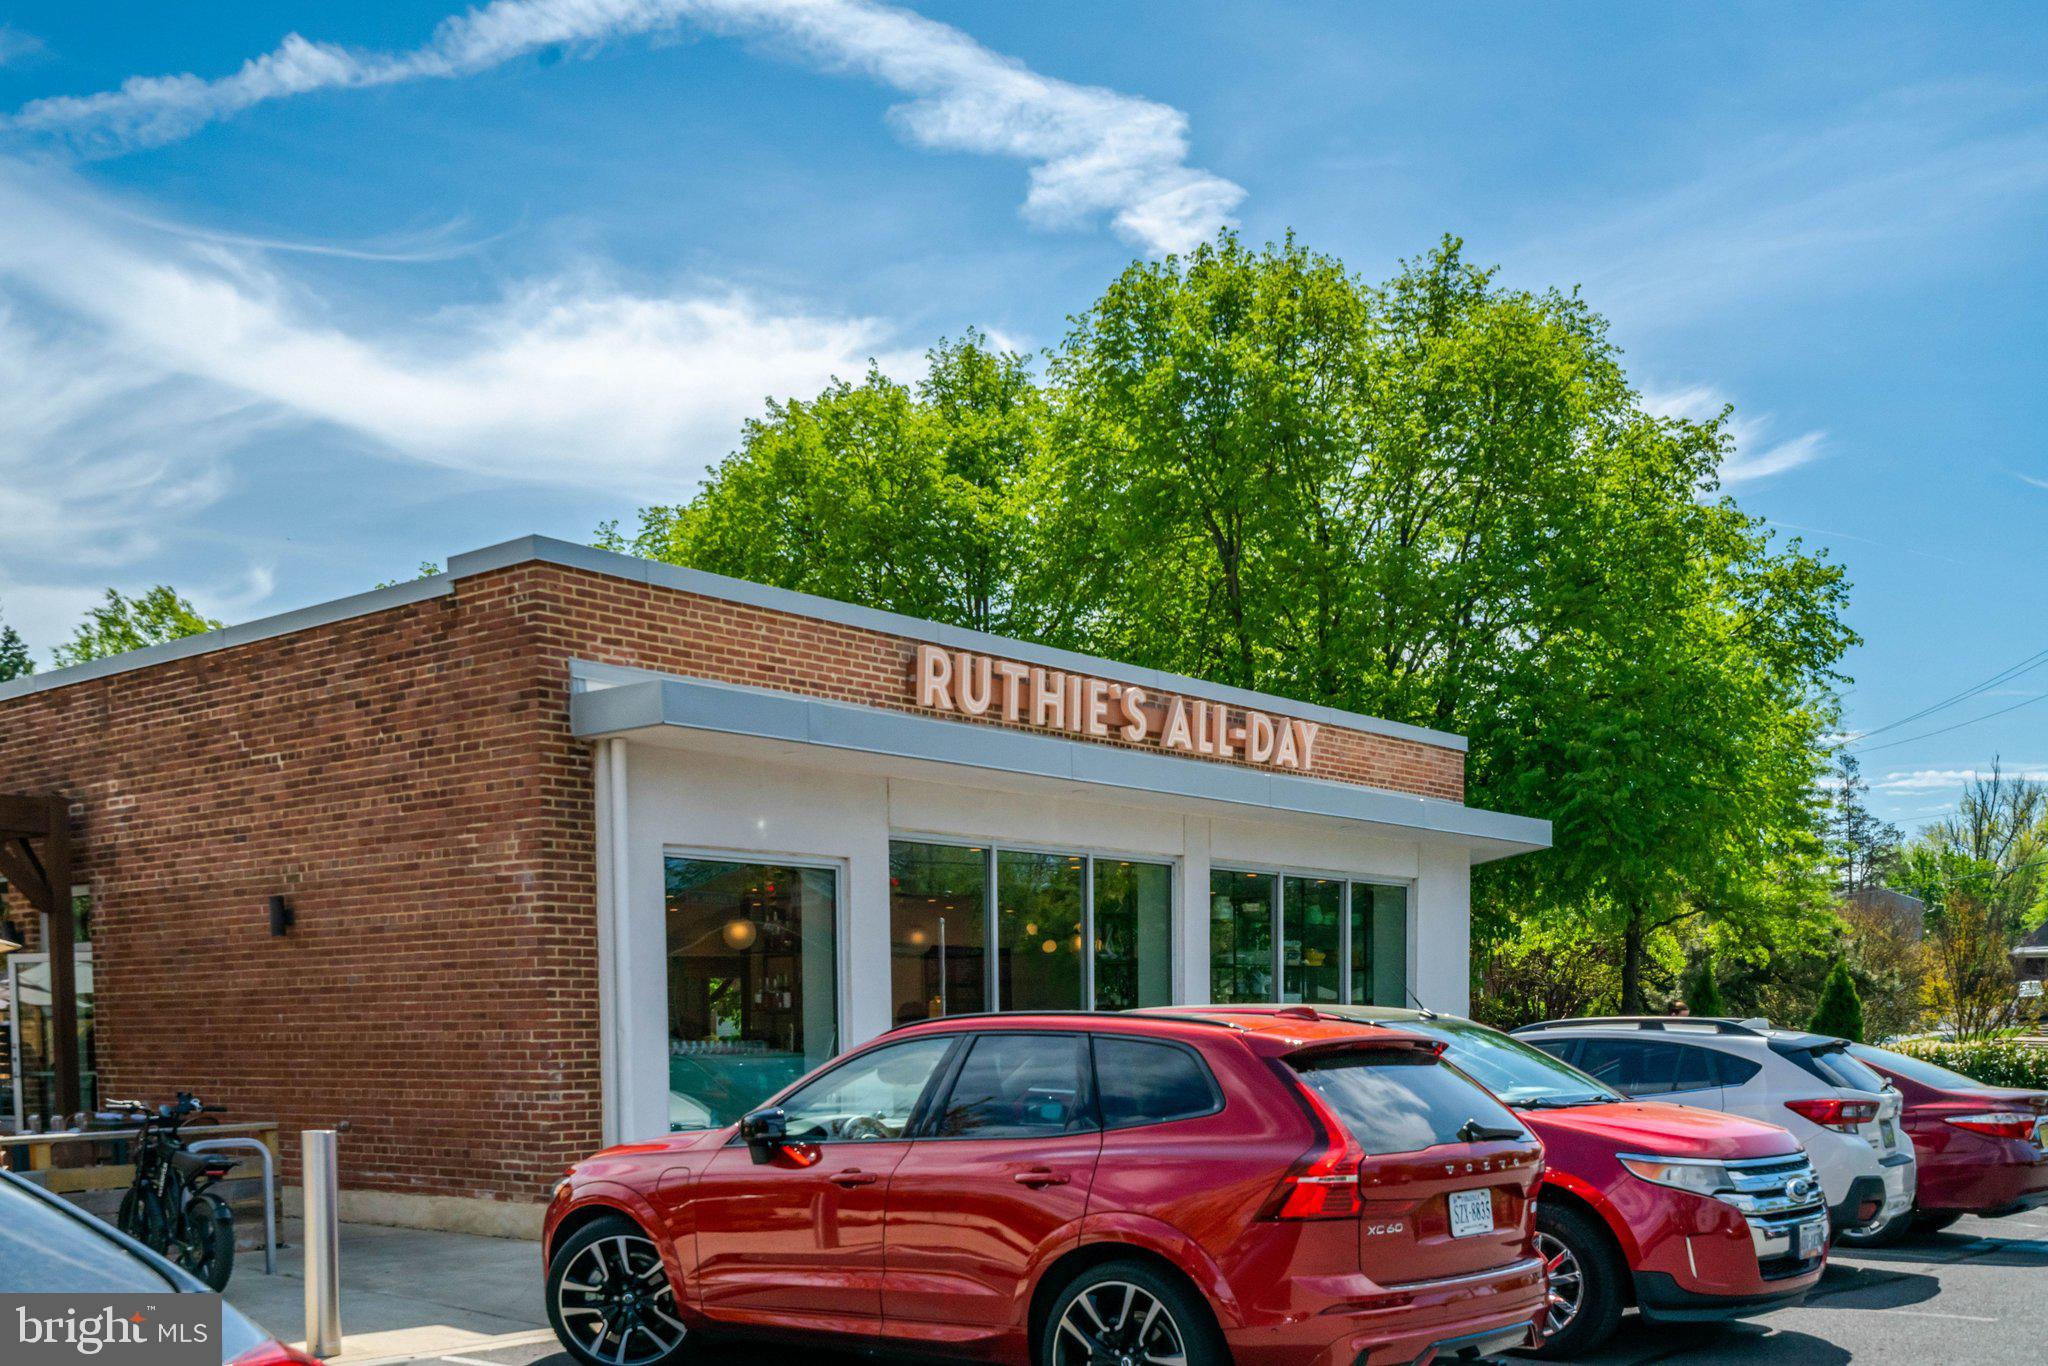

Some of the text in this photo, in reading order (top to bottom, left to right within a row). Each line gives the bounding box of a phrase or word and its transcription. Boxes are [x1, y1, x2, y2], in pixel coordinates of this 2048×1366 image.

[916, 644, 1319, 771] RUTHIE'S ALL-DAY
[1445, 1158, 1520, 1175] VOLVO
